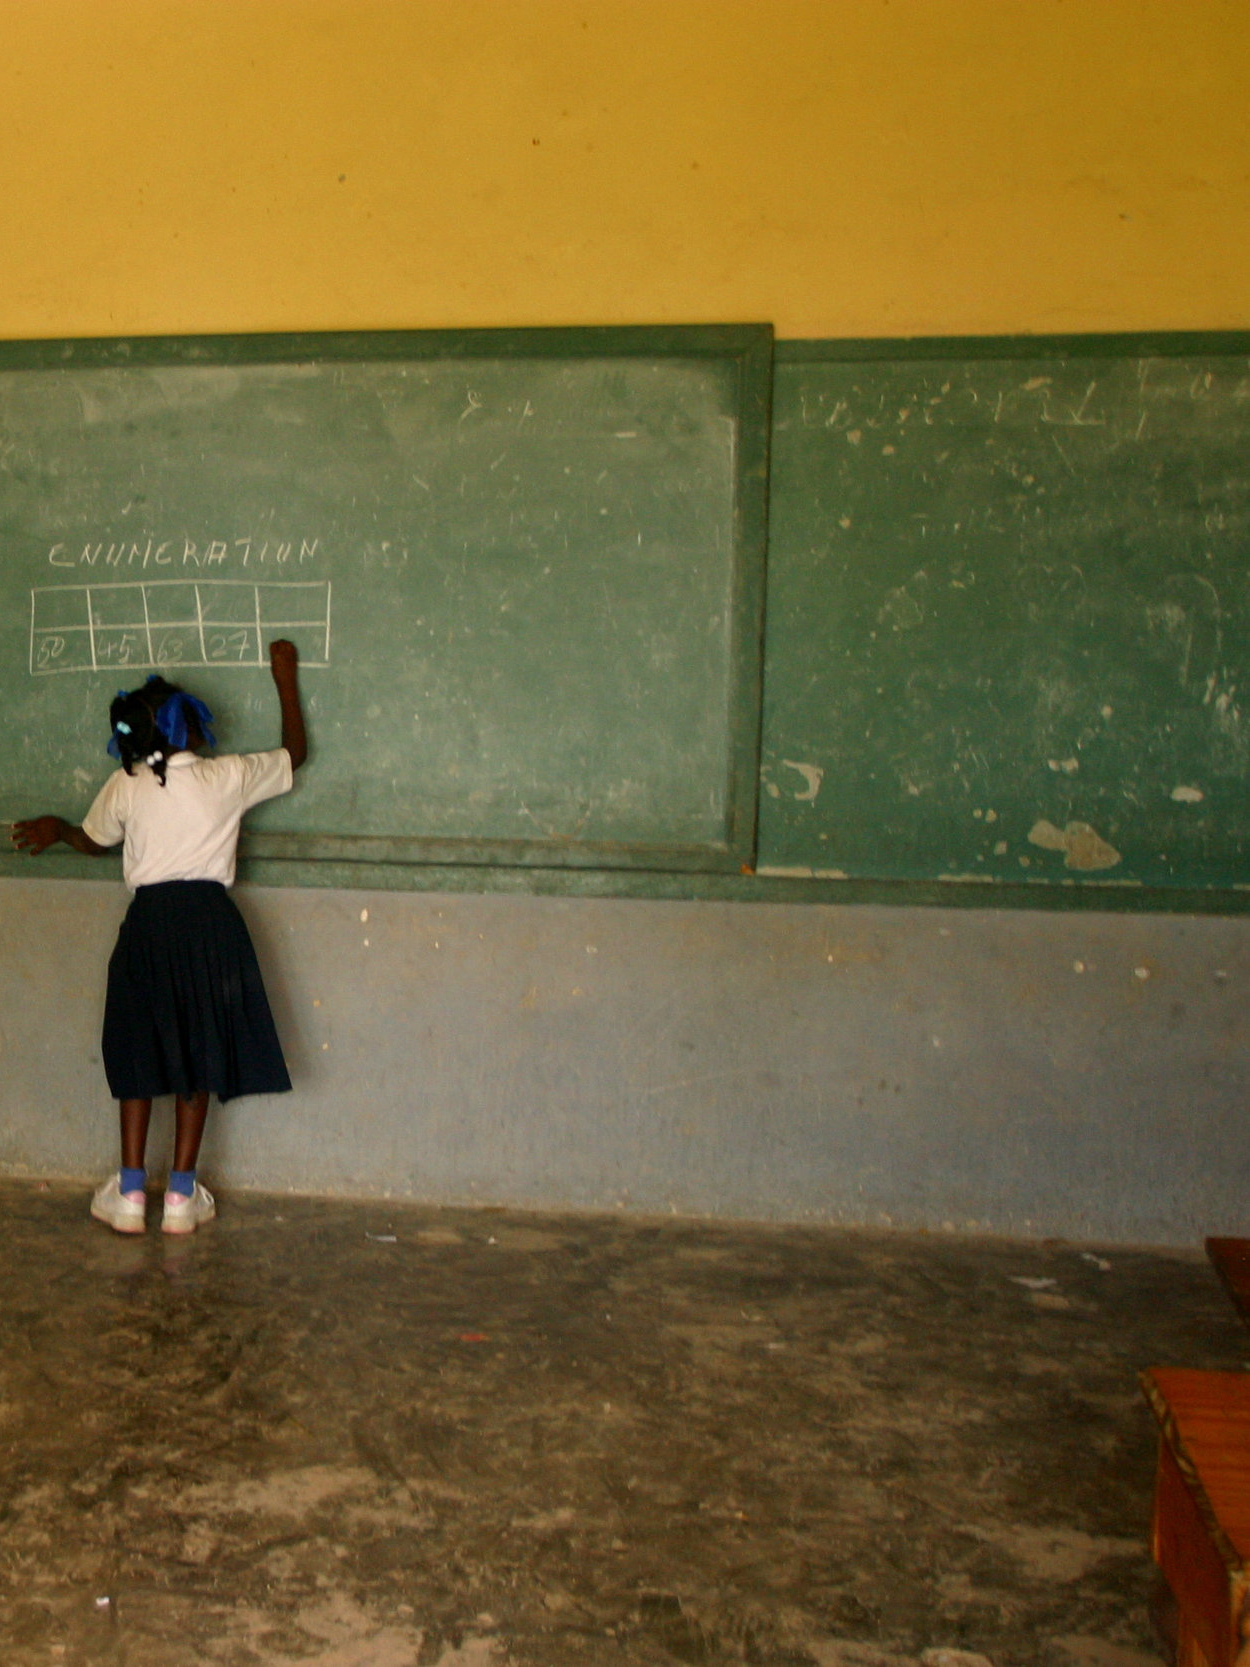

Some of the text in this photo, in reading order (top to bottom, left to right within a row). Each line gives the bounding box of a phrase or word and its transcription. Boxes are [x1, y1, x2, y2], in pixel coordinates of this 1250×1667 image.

[97, 633, 137, 665] 45
[156, 631, 184, 665] 63
[209, 630, 251, 661] 27
